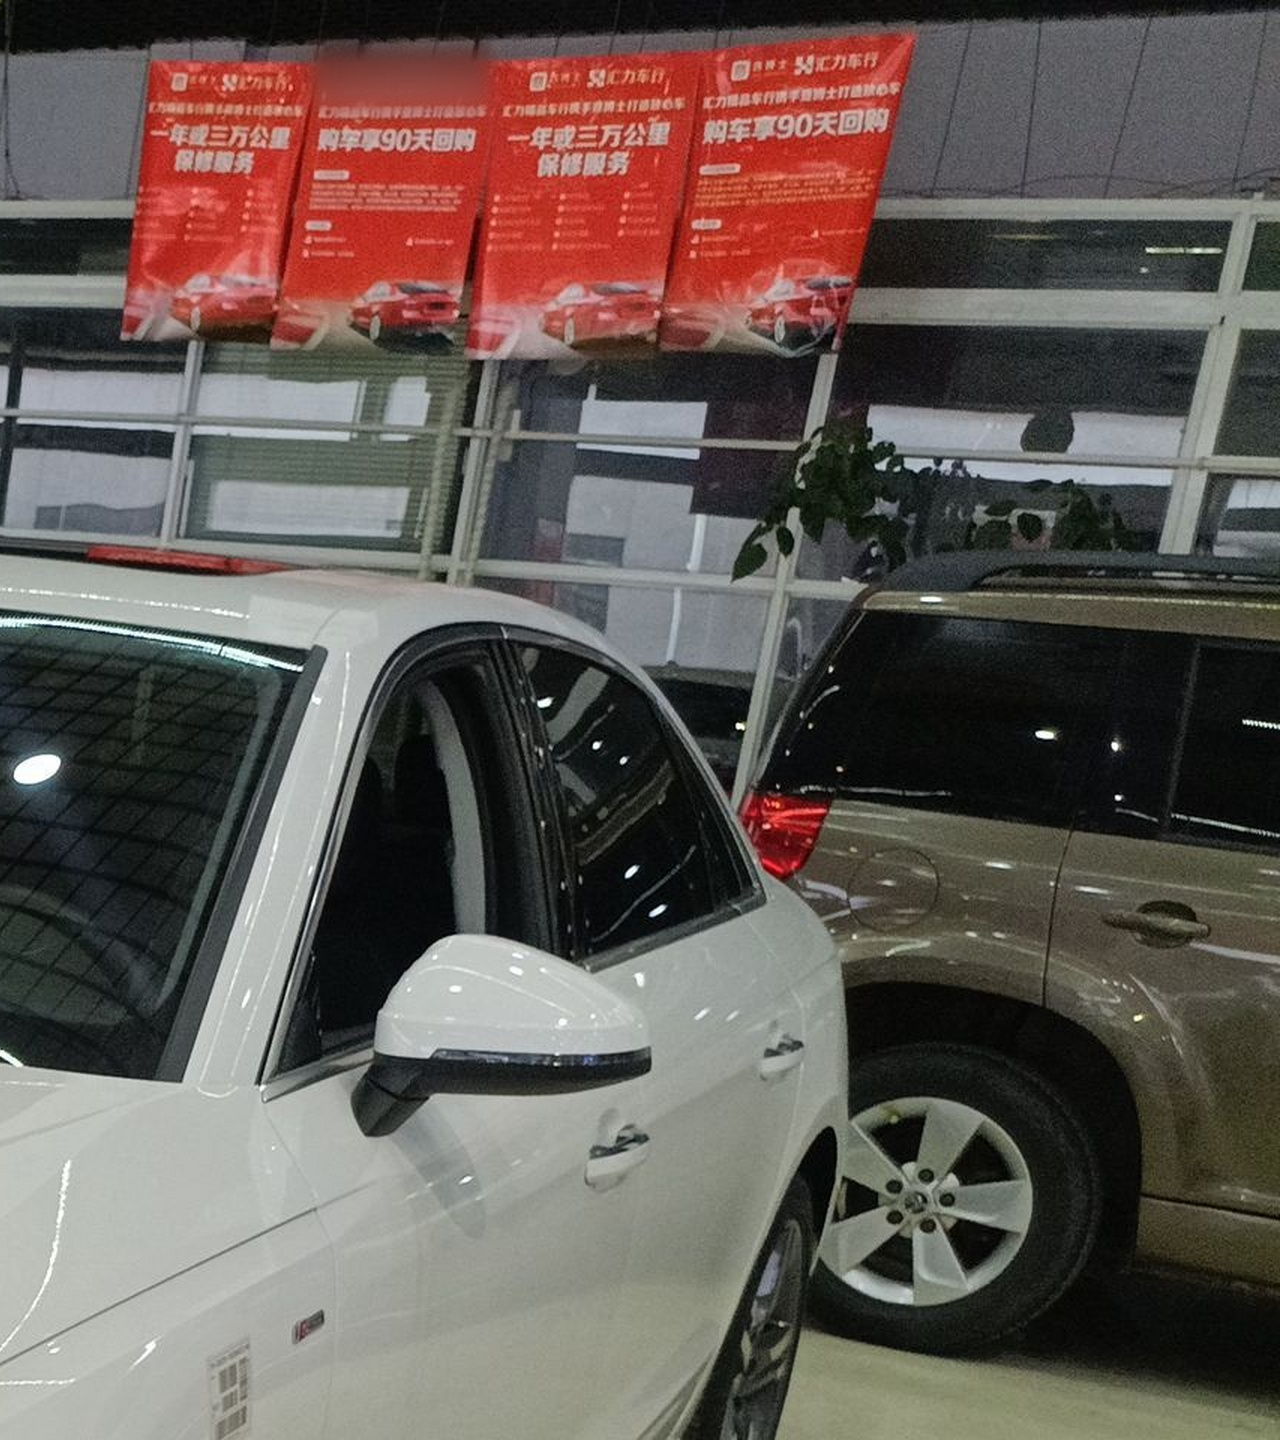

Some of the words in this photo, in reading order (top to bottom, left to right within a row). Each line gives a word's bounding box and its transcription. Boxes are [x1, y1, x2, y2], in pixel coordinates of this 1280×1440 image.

[150, 123, 290, 150] 一年或三万公里
[318, 126, 477, 152] 购车享90天回购
[507, 121, 671, 150] 一年或三万公里
[702, 108, 891, 145] 购车享90天回购
[174, 149, 254, 174] 保修服务
[537, 150, 631, 178] 保修服务
